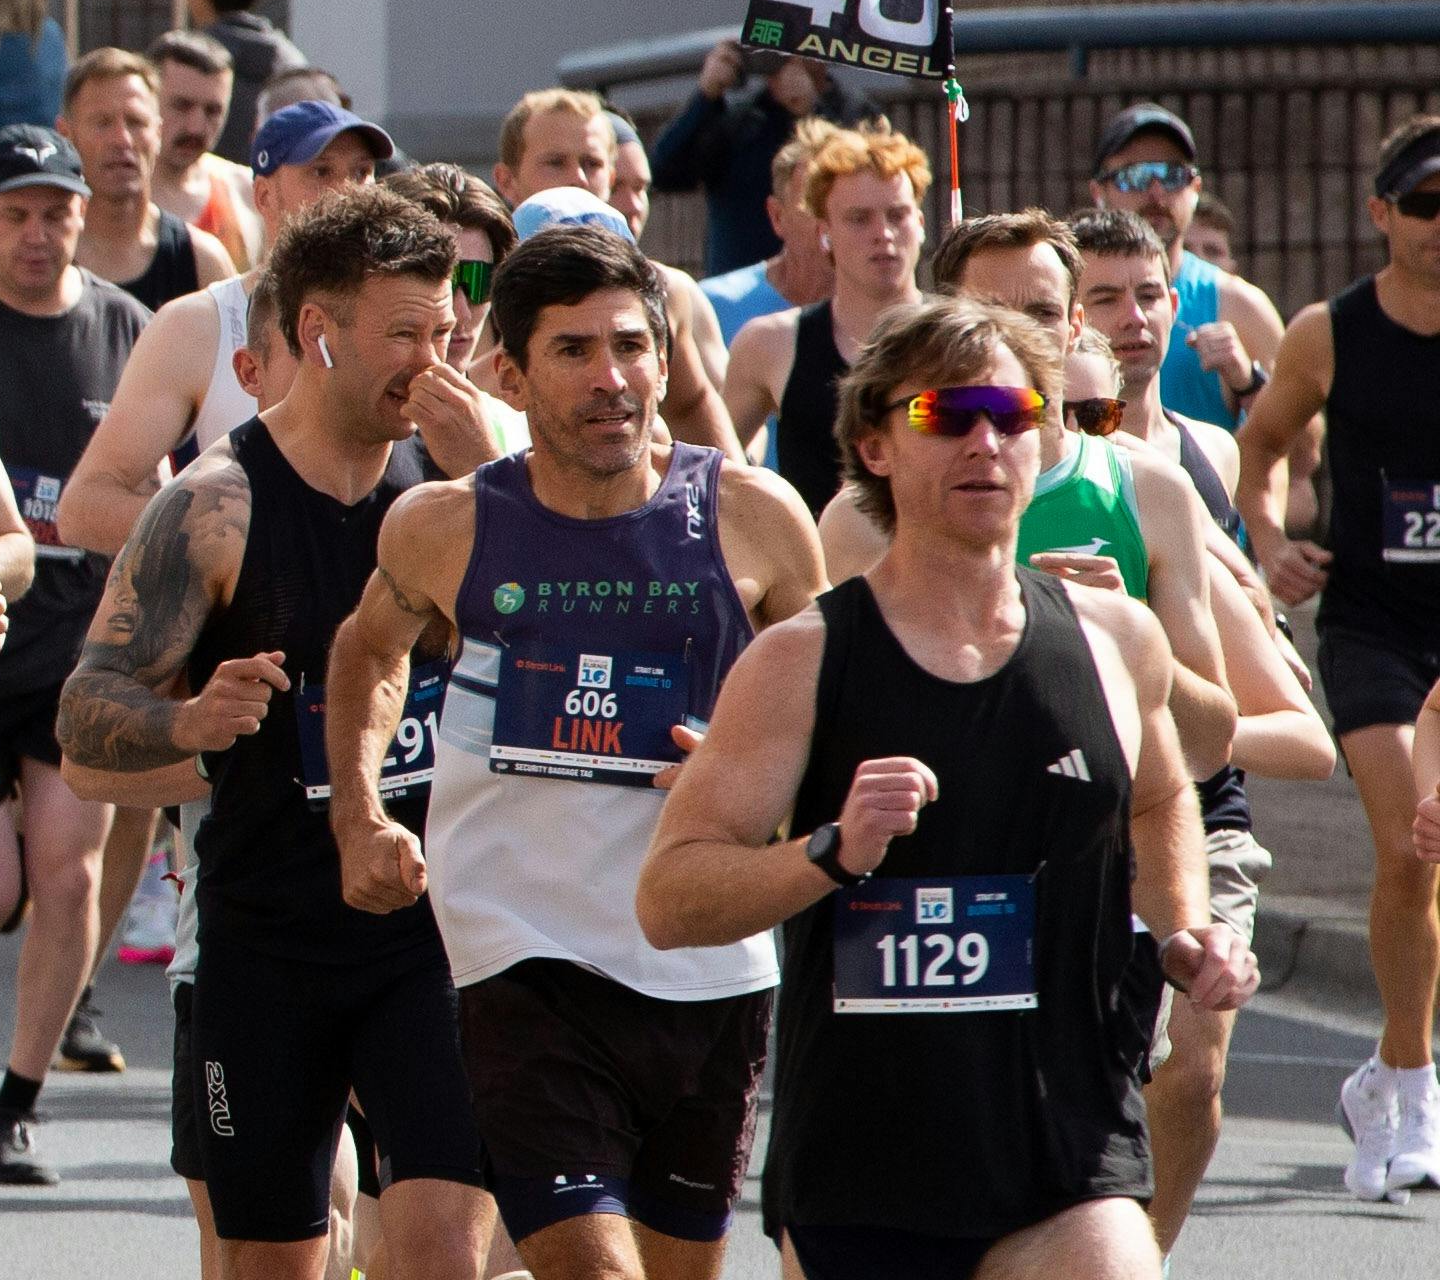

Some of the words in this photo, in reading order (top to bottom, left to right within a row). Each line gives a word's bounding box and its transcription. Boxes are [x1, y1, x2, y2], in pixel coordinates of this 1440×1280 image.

[796, 33, 943, 76] ANGEL
[685, 482, 703, 540] 2XU
[537, 600, 701, 614] RUNNERS
[538, 581, 633, 597] BYRON
[648, 581, 700, 597] BAY
[564, 690, 618, 719] 606
[381, 711, 440, 768] 91
[552, 717, 625, 755] LINK
[876, 932, 990, 987] 1129
[205, 1061, 235, 1137] 2XU
